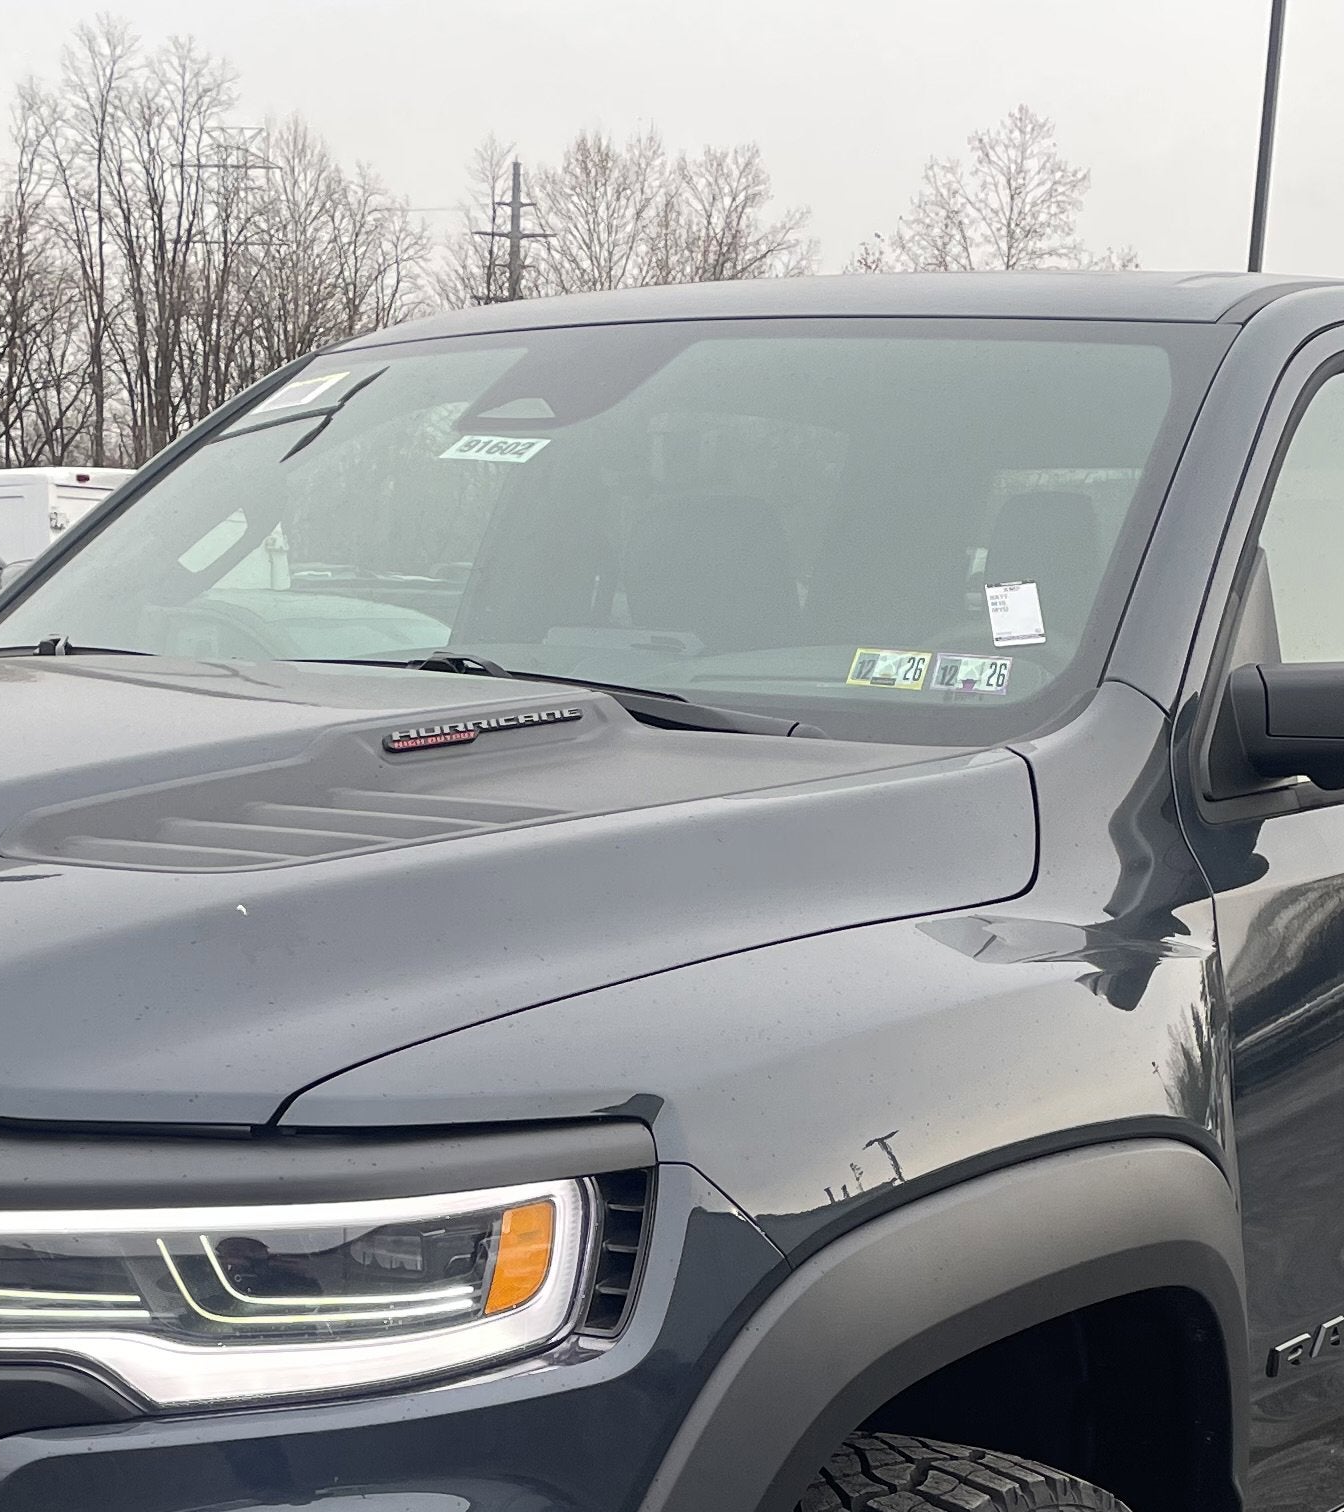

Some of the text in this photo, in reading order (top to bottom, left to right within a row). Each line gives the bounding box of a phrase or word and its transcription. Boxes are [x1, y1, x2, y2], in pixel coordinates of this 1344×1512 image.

[459, 439, 535, 455] 91602
[856, 656, 925, 681] 12 26
[936, 661, 1007, 687] 12 26
[392, 709, 581, 740] HURRICANE
[393, 732, 477, 749] HIGH OUTPUT
